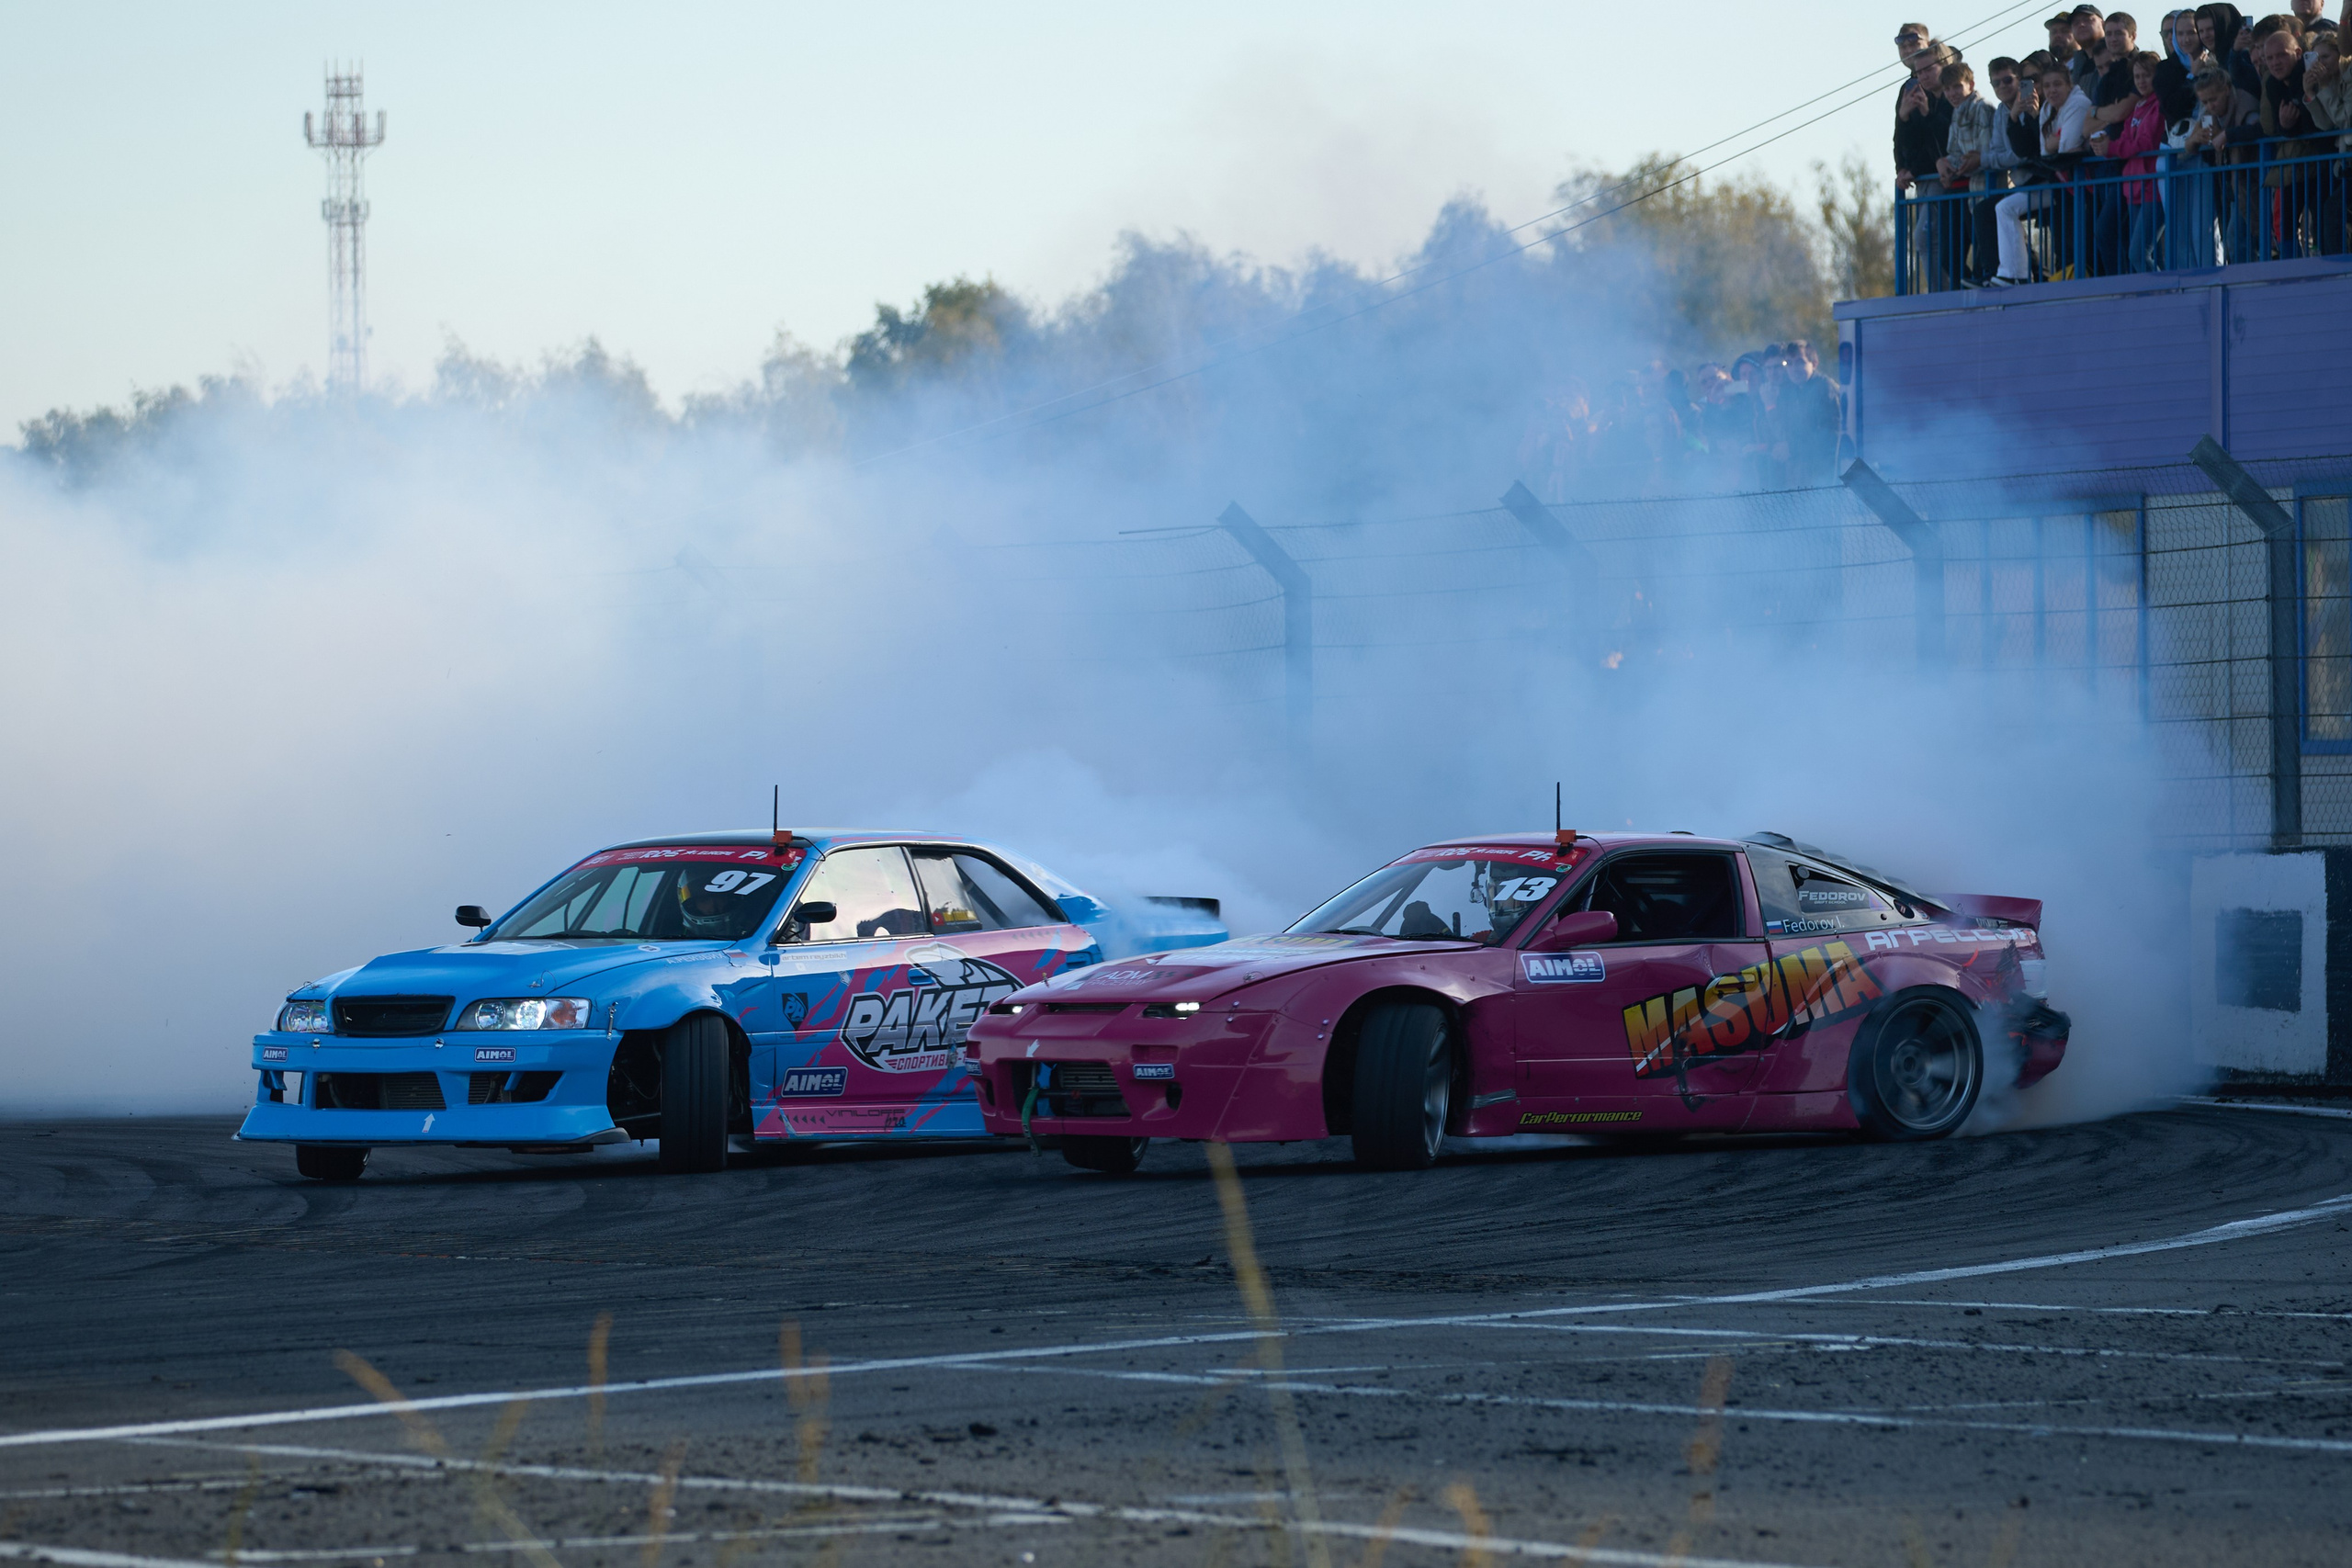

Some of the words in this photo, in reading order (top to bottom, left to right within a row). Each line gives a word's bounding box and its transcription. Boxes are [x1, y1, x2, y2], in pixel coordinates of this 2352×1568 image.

[705, 870, 776, 896] 97
[1493, 876, 1557, 902] 13
[1798, 890, 1866, 901] FEDOROV
[1782, 917, 1834, 933] Fedorov
[1529, 958, 1601, 976] AIMOL
[1623, 941, 1884, 1078] MASUMA
[263, 1049, 287, 1059] AIMOL
[477, 1050, 514, 1060] AIMOL
[1136, 1067, 1171, 1077] AIMOL
[785, 1073, 842, 1091] AIMOL
[826, 1109, 906, 1117] VINILOFF
[1519, 1111, 1644, 1125] CarPerformance
